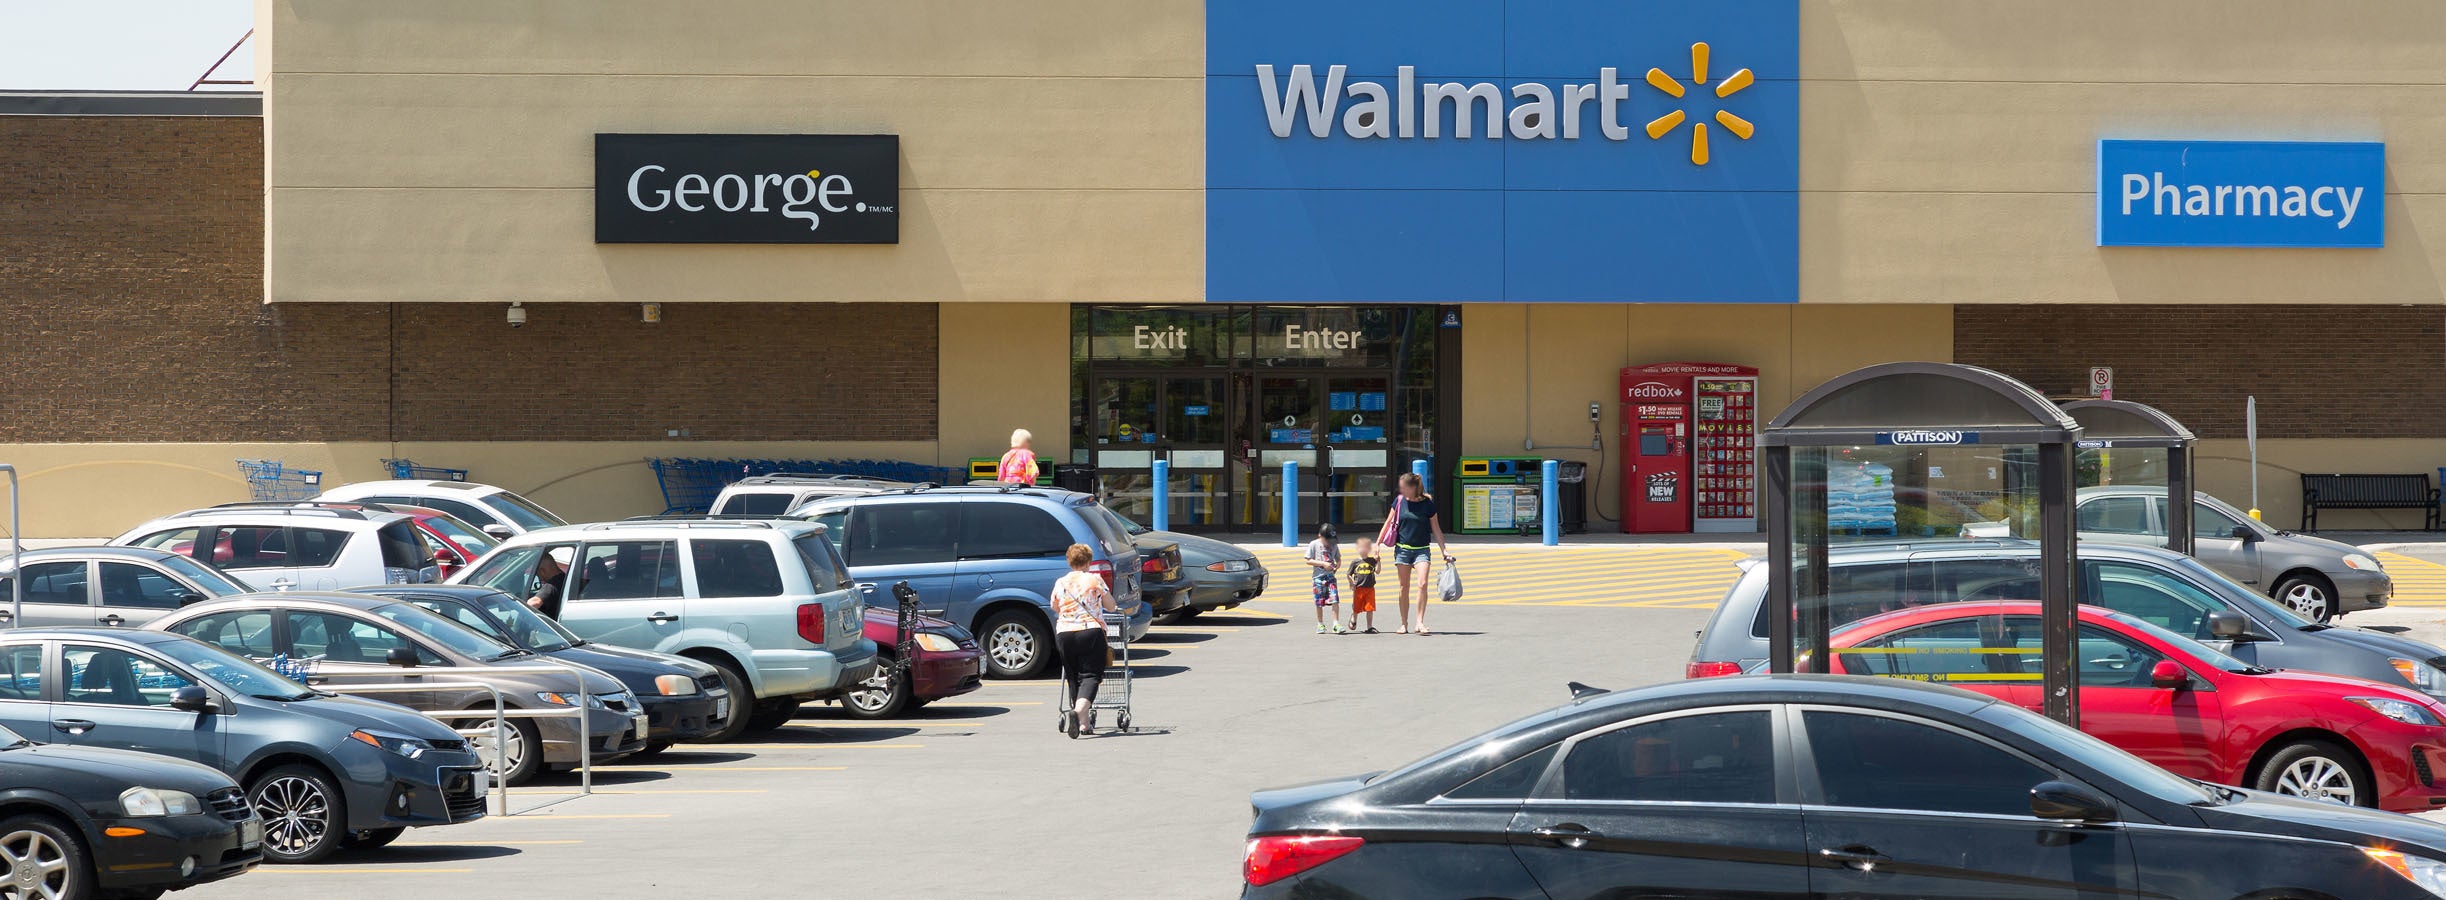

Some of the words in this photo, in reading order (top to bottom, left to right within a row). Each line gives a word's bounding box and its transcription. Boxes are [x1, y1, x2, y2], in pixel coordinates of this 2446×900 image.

[1255, 64, 1629, 141] Walmart
[2121, 172, 2364, 230] Pharmacy
[868, 205, 894, 213] TM/MC
[1134, 325, 1188, 349] Exit
[1285, 324, 1362, 349] Enter
[1628, 384, 1675, 397] redbox
[1701, 399, 1722, 407] FREE
[1638, 405, 1657, 415] $1.50
[1897, 432, 1957, 442] PATTISON
[1649, 486, 1674, 497] NEW
